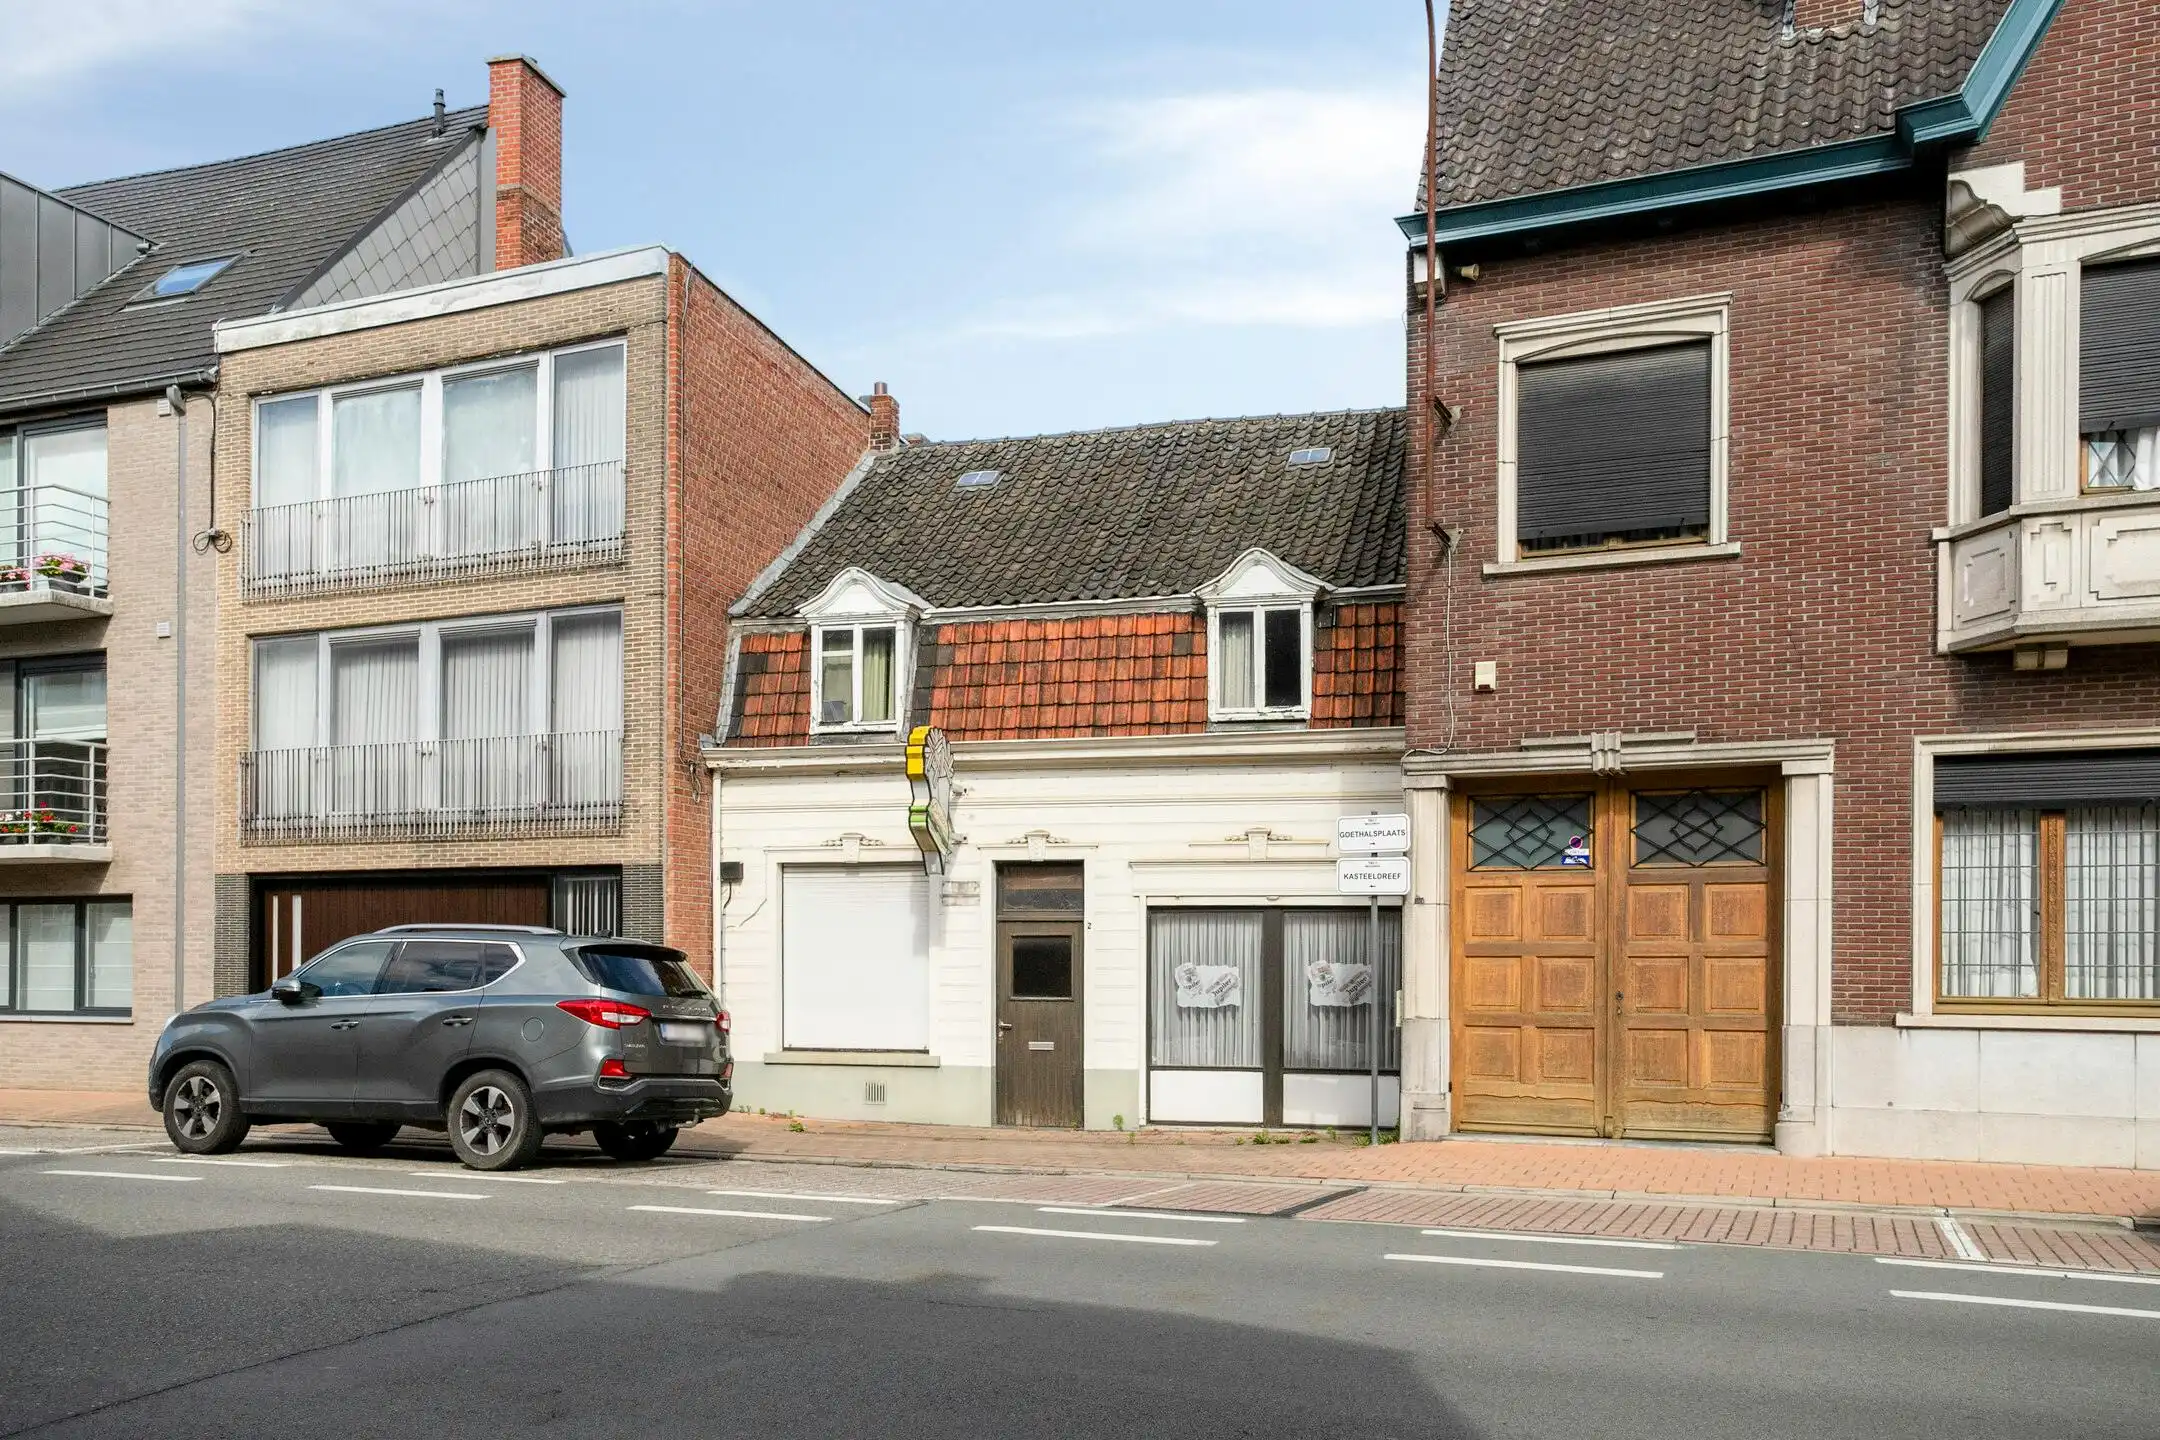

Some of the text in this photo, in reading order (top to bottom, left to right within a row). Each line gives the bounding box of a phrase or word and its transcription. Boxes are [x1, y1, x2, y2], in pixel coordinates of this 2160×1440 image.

[1340, 829, 1406, 838] GOETHALSPLAATS
[1343, 872, 1402, 880] KASTEELDREEF
[1211, 978, 1232, 996] Jupiler
[1346, 975, 1368, 995] Jupiler
